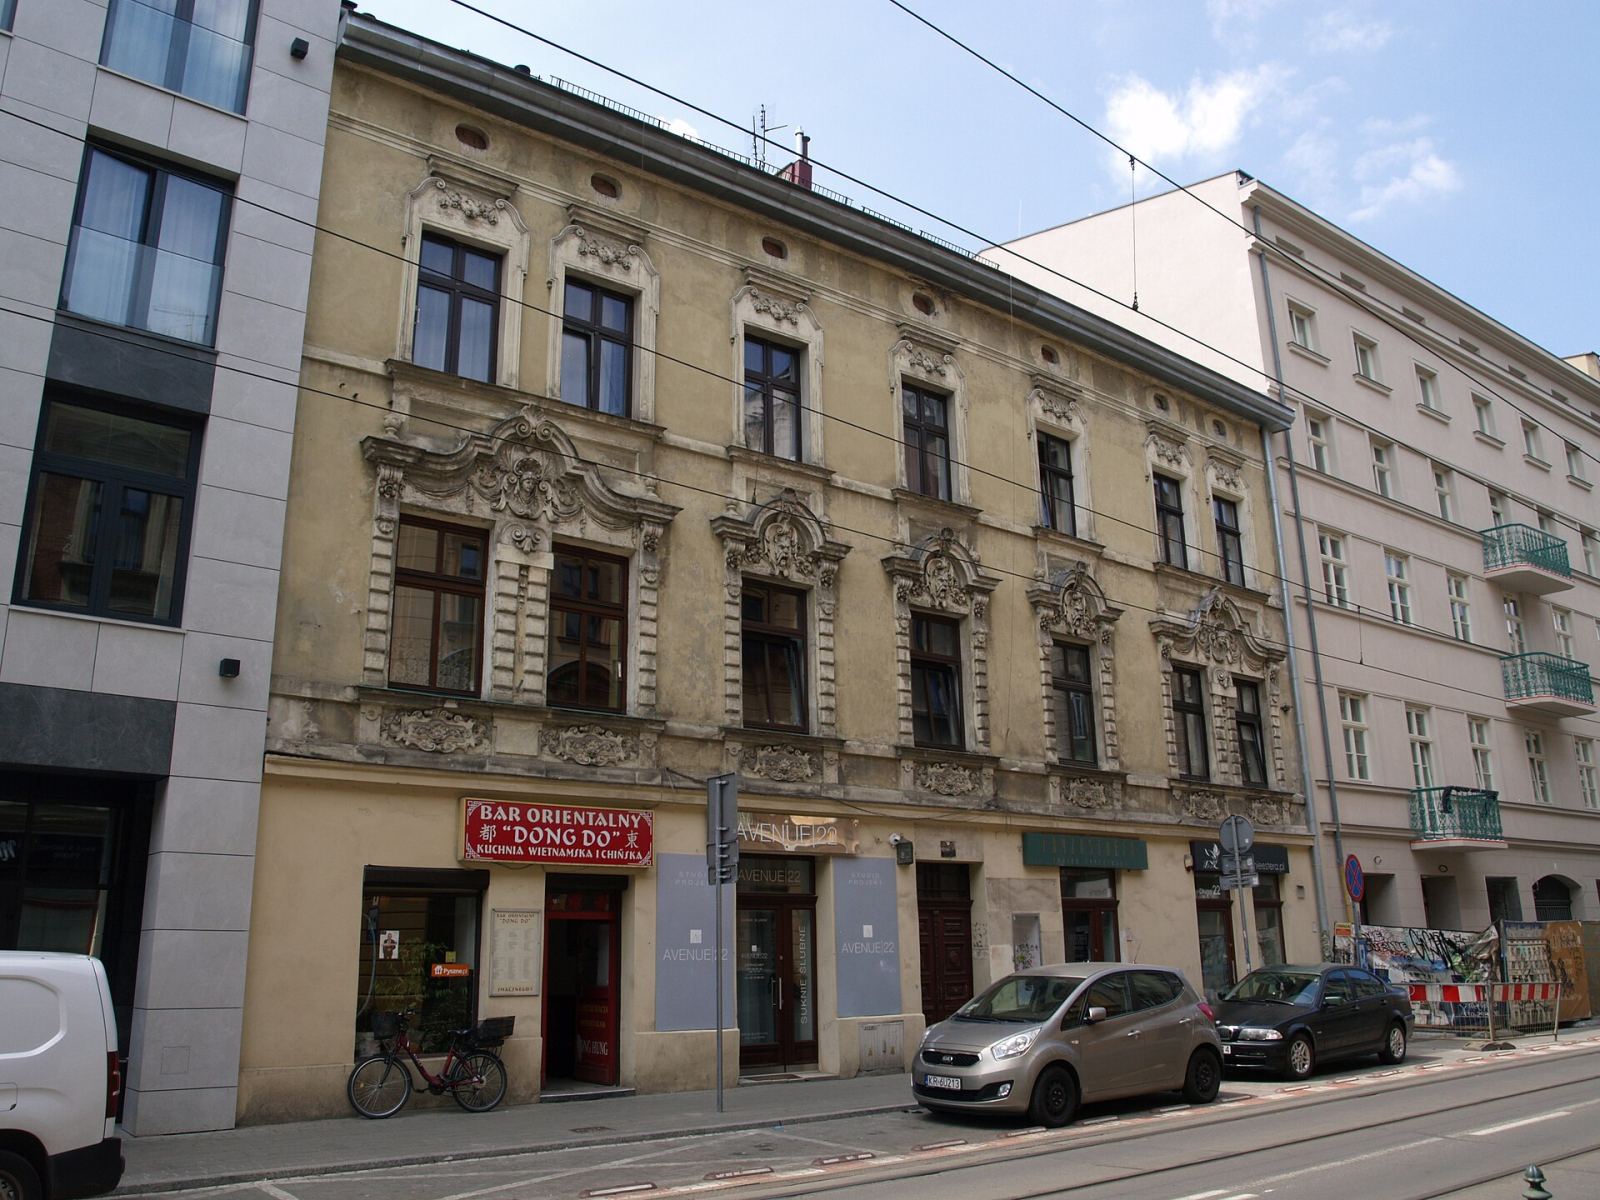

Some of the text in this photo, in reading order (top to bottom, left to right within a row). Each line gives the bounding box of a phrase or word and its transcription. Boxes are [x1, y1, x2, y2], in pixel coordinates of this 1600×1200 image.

[480, 805, 641, 828] BAR ORIENTALNY
[625, 830, 639, 849] 東
[477, 844, 643, 860] KUCHNIA WIETNAMSKA I CHIŃSKA
[800, 980, 809, 1024] SUKNIE
